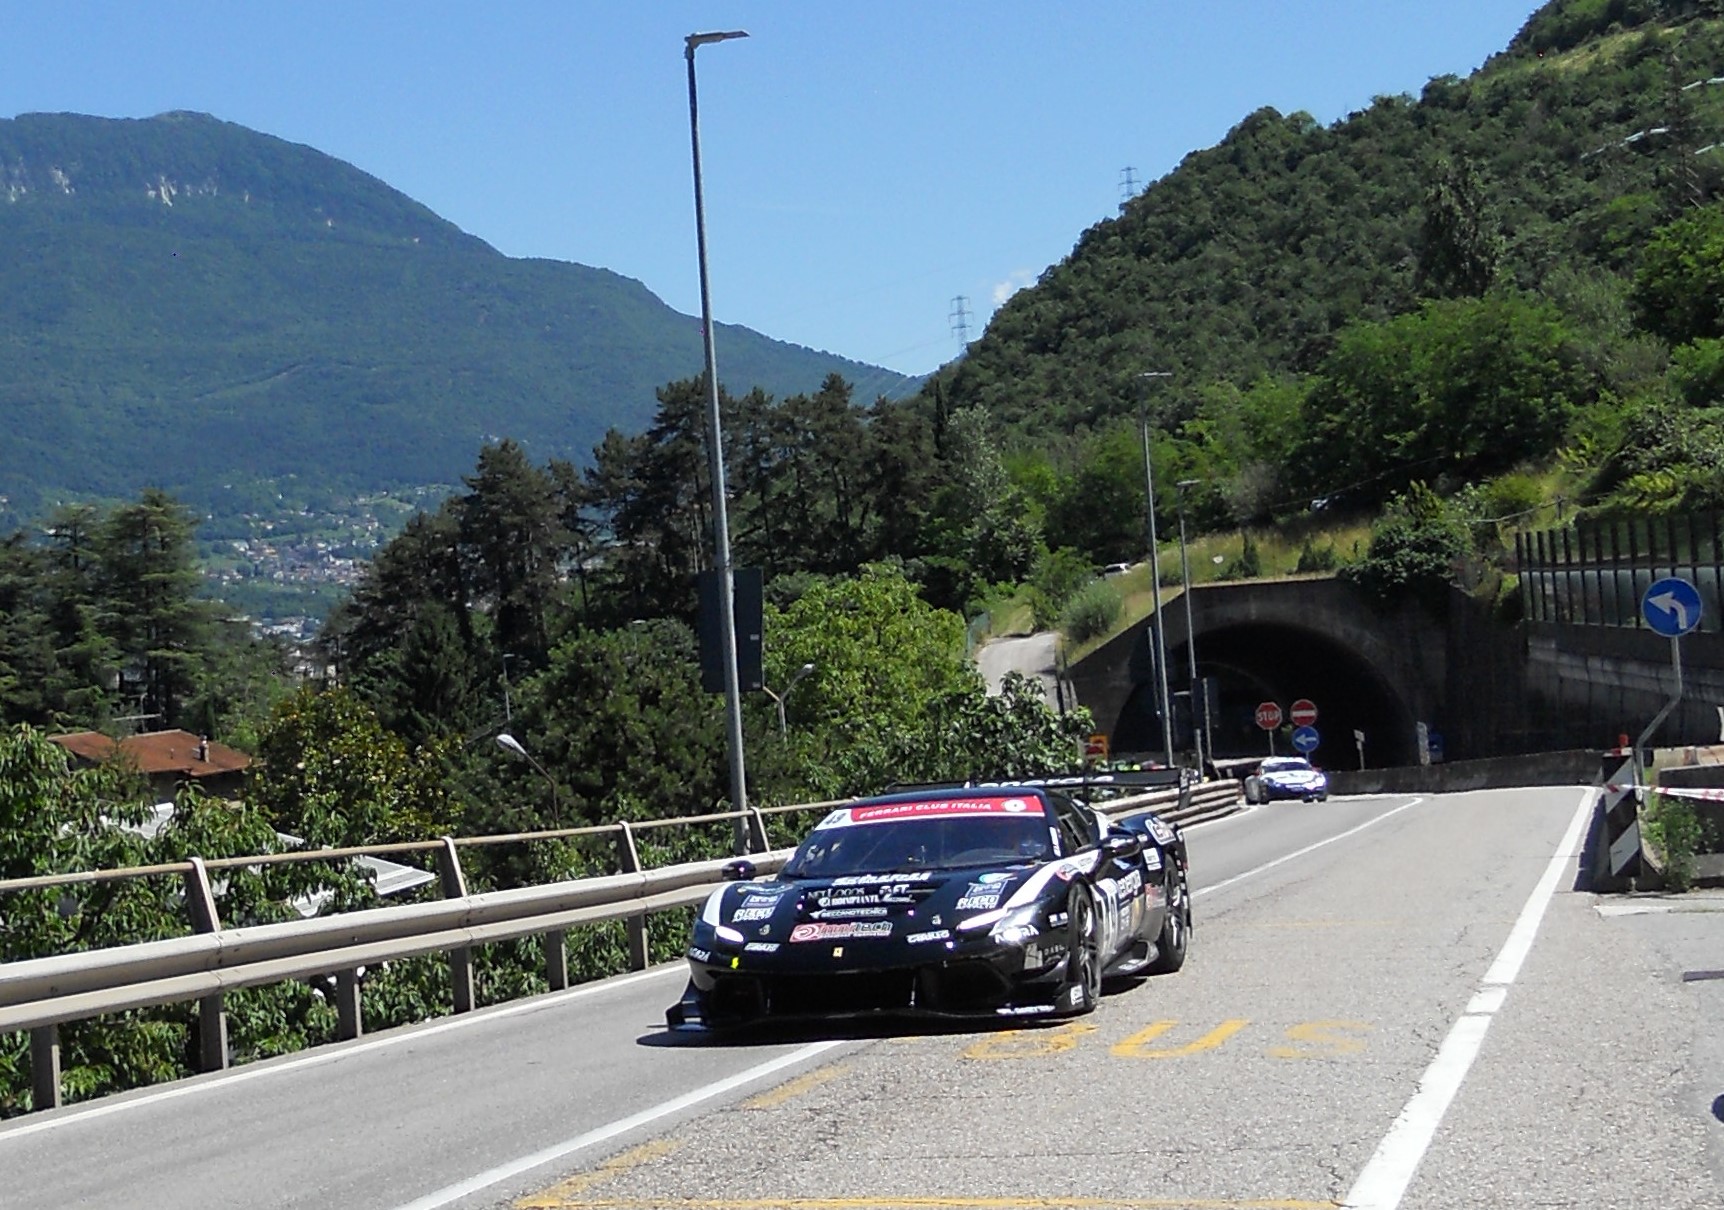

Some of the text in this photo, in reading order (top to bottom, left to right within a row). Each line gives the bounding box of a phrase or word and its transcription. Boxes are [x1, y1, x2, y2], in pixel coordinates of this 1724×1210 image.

[1256, 710, 1280, 722] STOP
[859, 801, 992, 819] FERRARI CLUB ITALIA
